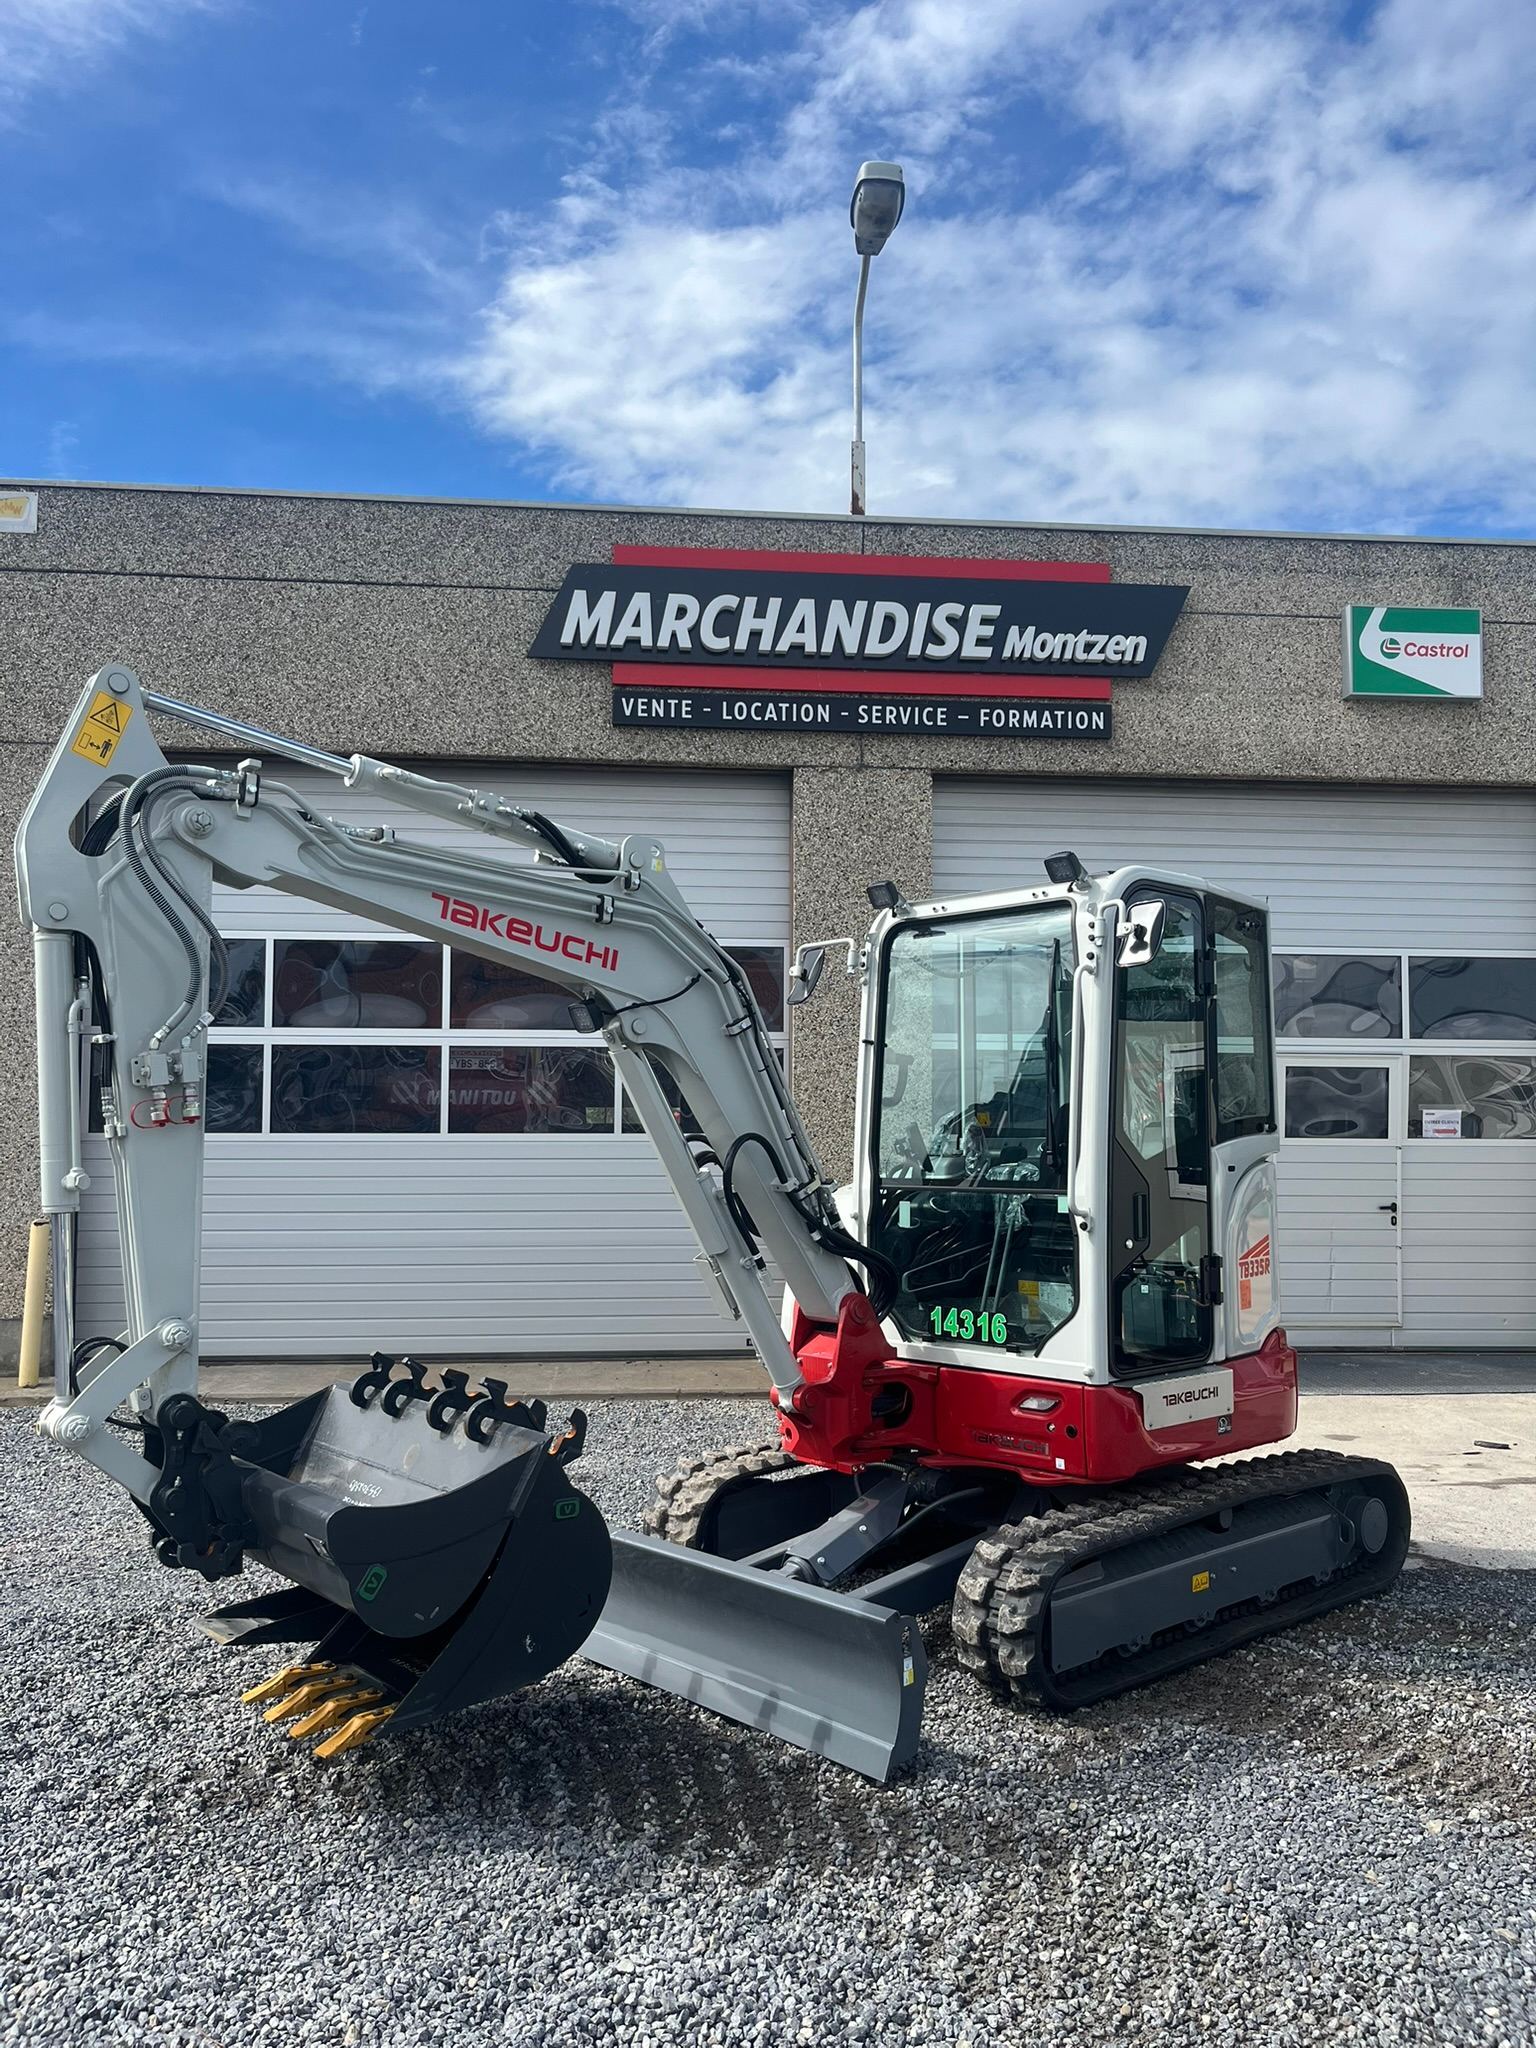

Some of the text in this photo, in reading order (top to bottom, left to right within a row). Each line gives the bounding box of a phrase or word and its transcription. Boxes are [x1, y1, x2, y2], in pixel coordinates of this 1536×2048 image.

[559, 589, 1148, 664] MARCHANDISE Montzen
[1403, 642, 1470, 659] Castrol
[621, 697, 692, 719] VENTE
[722, 701, 830, 723] LOCATION
[857, 704, 948, 726] SERVICE
[980, 708, 1104, 730] FORMATION
[1239, 1258, 1271, 1280] TB335R
[930, 1305, 1008, 1344] 14316
